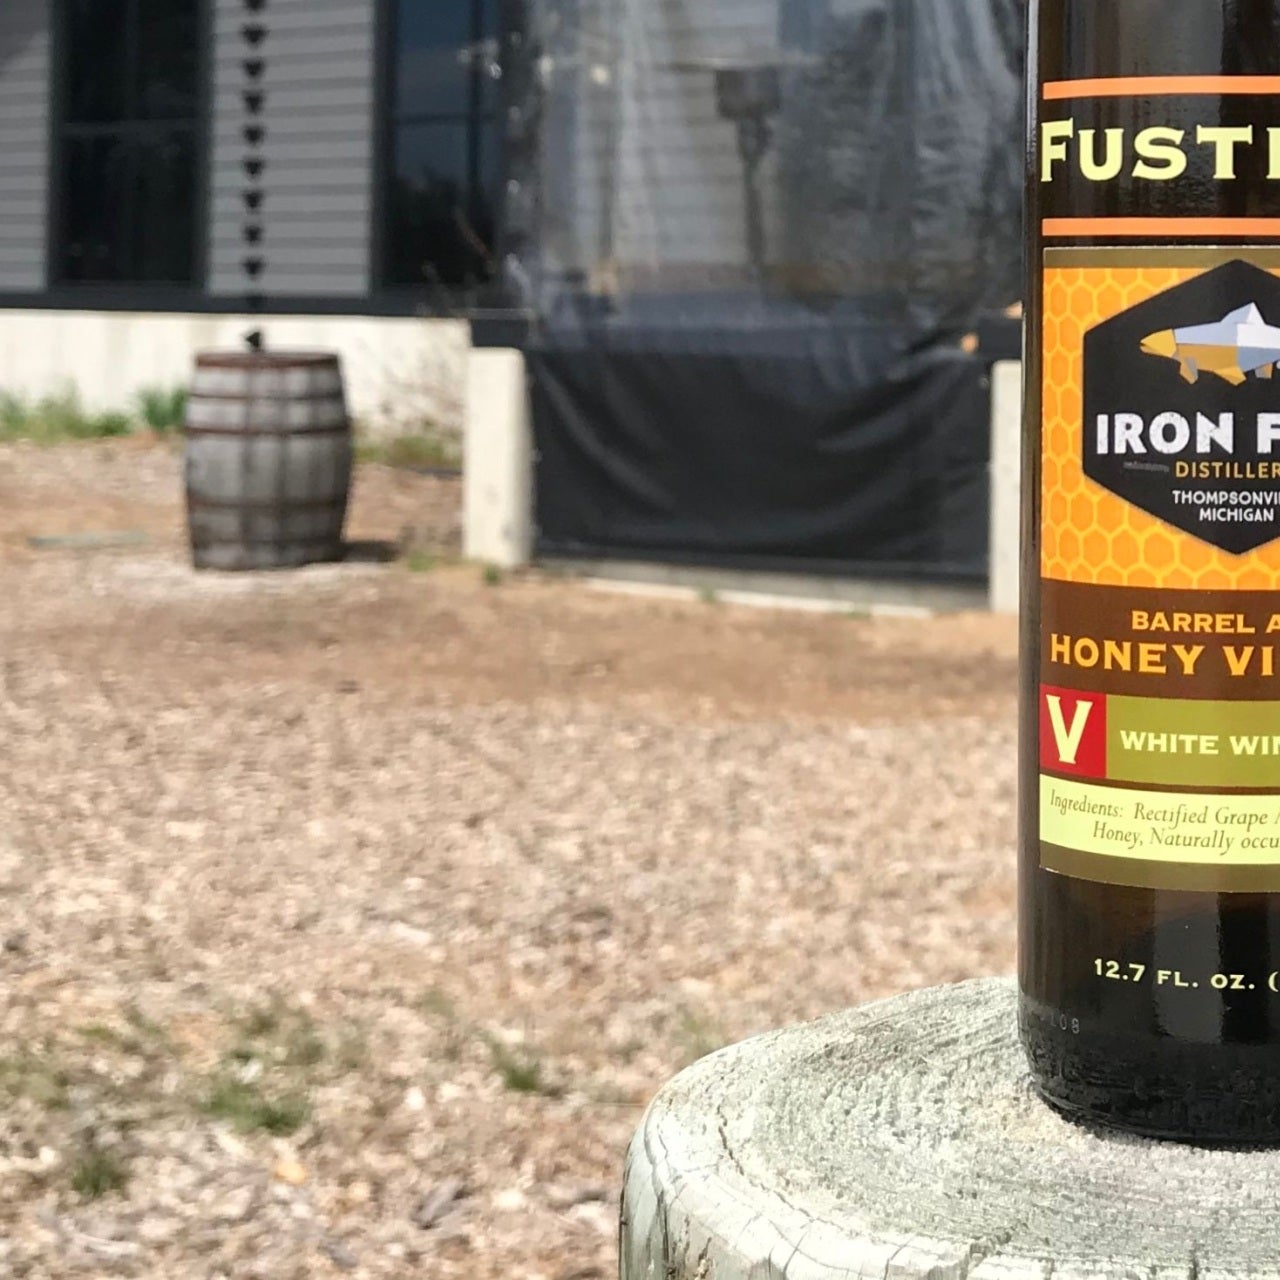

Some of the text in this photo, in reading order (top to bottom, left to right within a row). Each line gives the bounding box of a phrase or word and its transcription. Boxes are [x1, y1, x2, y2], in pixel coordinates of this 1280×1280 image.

[1096, 412, 1234, 455] IRON
[1199, 508, 1275, 522] MICHIGAN
[1131, 609, 1255, 634] BARREL
[1050, 634, 1205, 676] HONEY
[1046, 694, 1093, 765] V
[1120, 730, 1219, 755] WHITE
[1050, 789, 1123, 819] Ingredients:
[1134, 802, 1208, 828] Rectified
[1214, 807, 1269, 831] Grape
[1093, 821, 1144, 849] Honey,
[1150, 828, 1236, 855] Naturally
[1094, 958, 1145, 982] 12.7
[1157, 970, 1198, 989] FL.
[1211, 972, 1255, 990] OZ.
